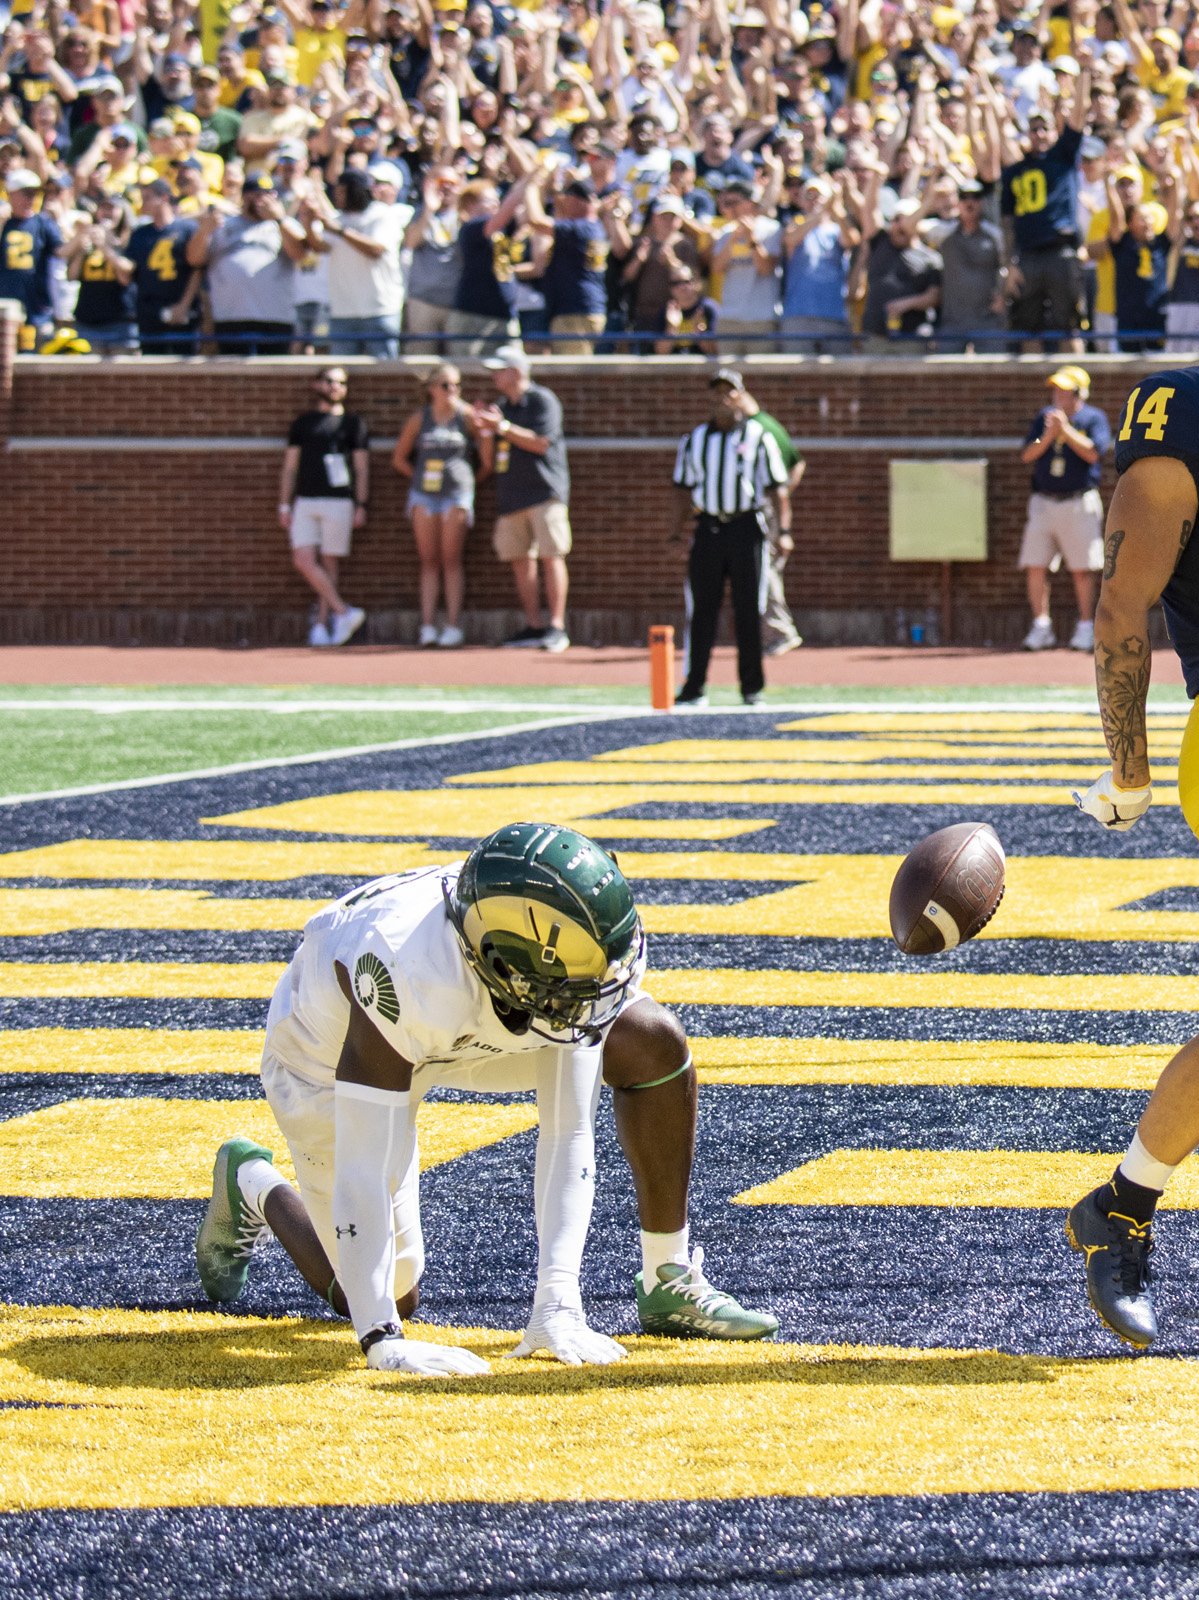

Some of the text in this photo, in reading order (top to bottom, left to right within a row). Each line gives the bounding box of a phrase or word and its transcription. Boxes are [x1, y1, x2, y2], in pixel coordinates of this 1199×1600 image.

[6, 230, 34, 269] 2
[148, 236, 178, 281] 4
[1118, 387, 1176, 441] 14
